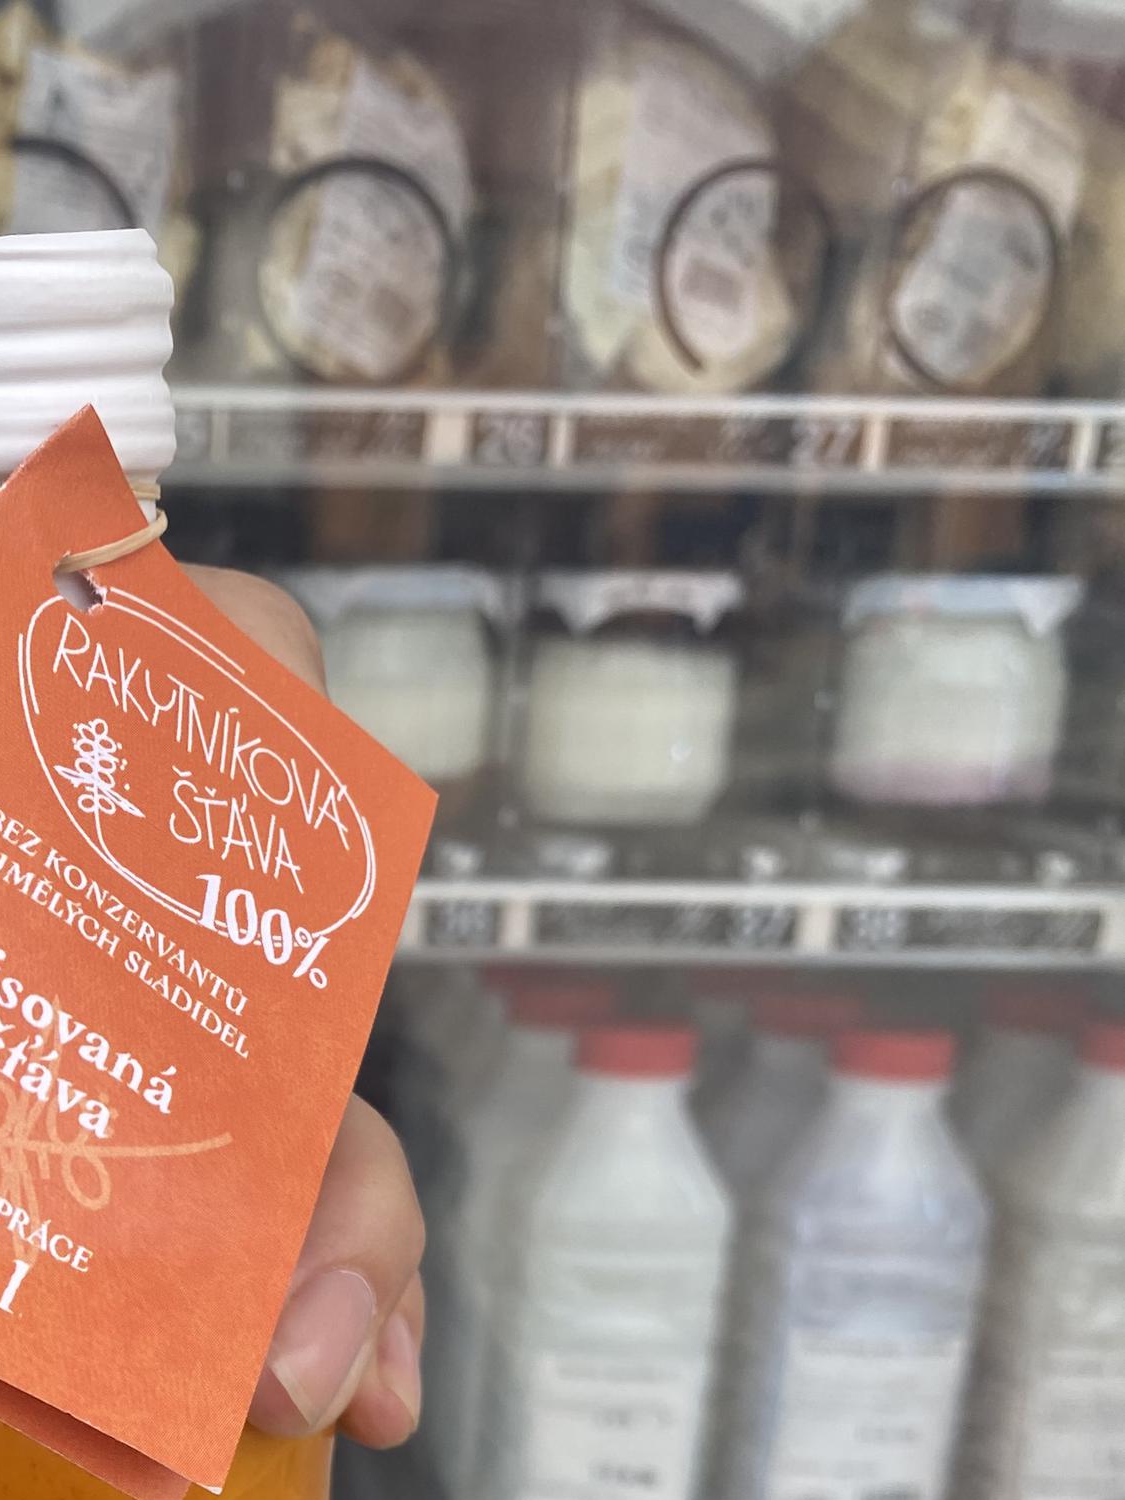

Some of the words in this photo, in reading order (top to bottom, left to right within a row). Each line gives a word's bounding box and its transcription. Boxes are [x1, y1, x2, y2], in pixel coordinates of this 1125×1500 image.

[53, 613, 350, 851] RAKYTNÍKOVÁ
[169, 765, 305, 894] ŠŤÁVA
[44, 847, 248, 1017] KONZERVANTŮ
[195, 874, 328, 989] 100%
[124, 950, 249, 1058] SLADIDEL
